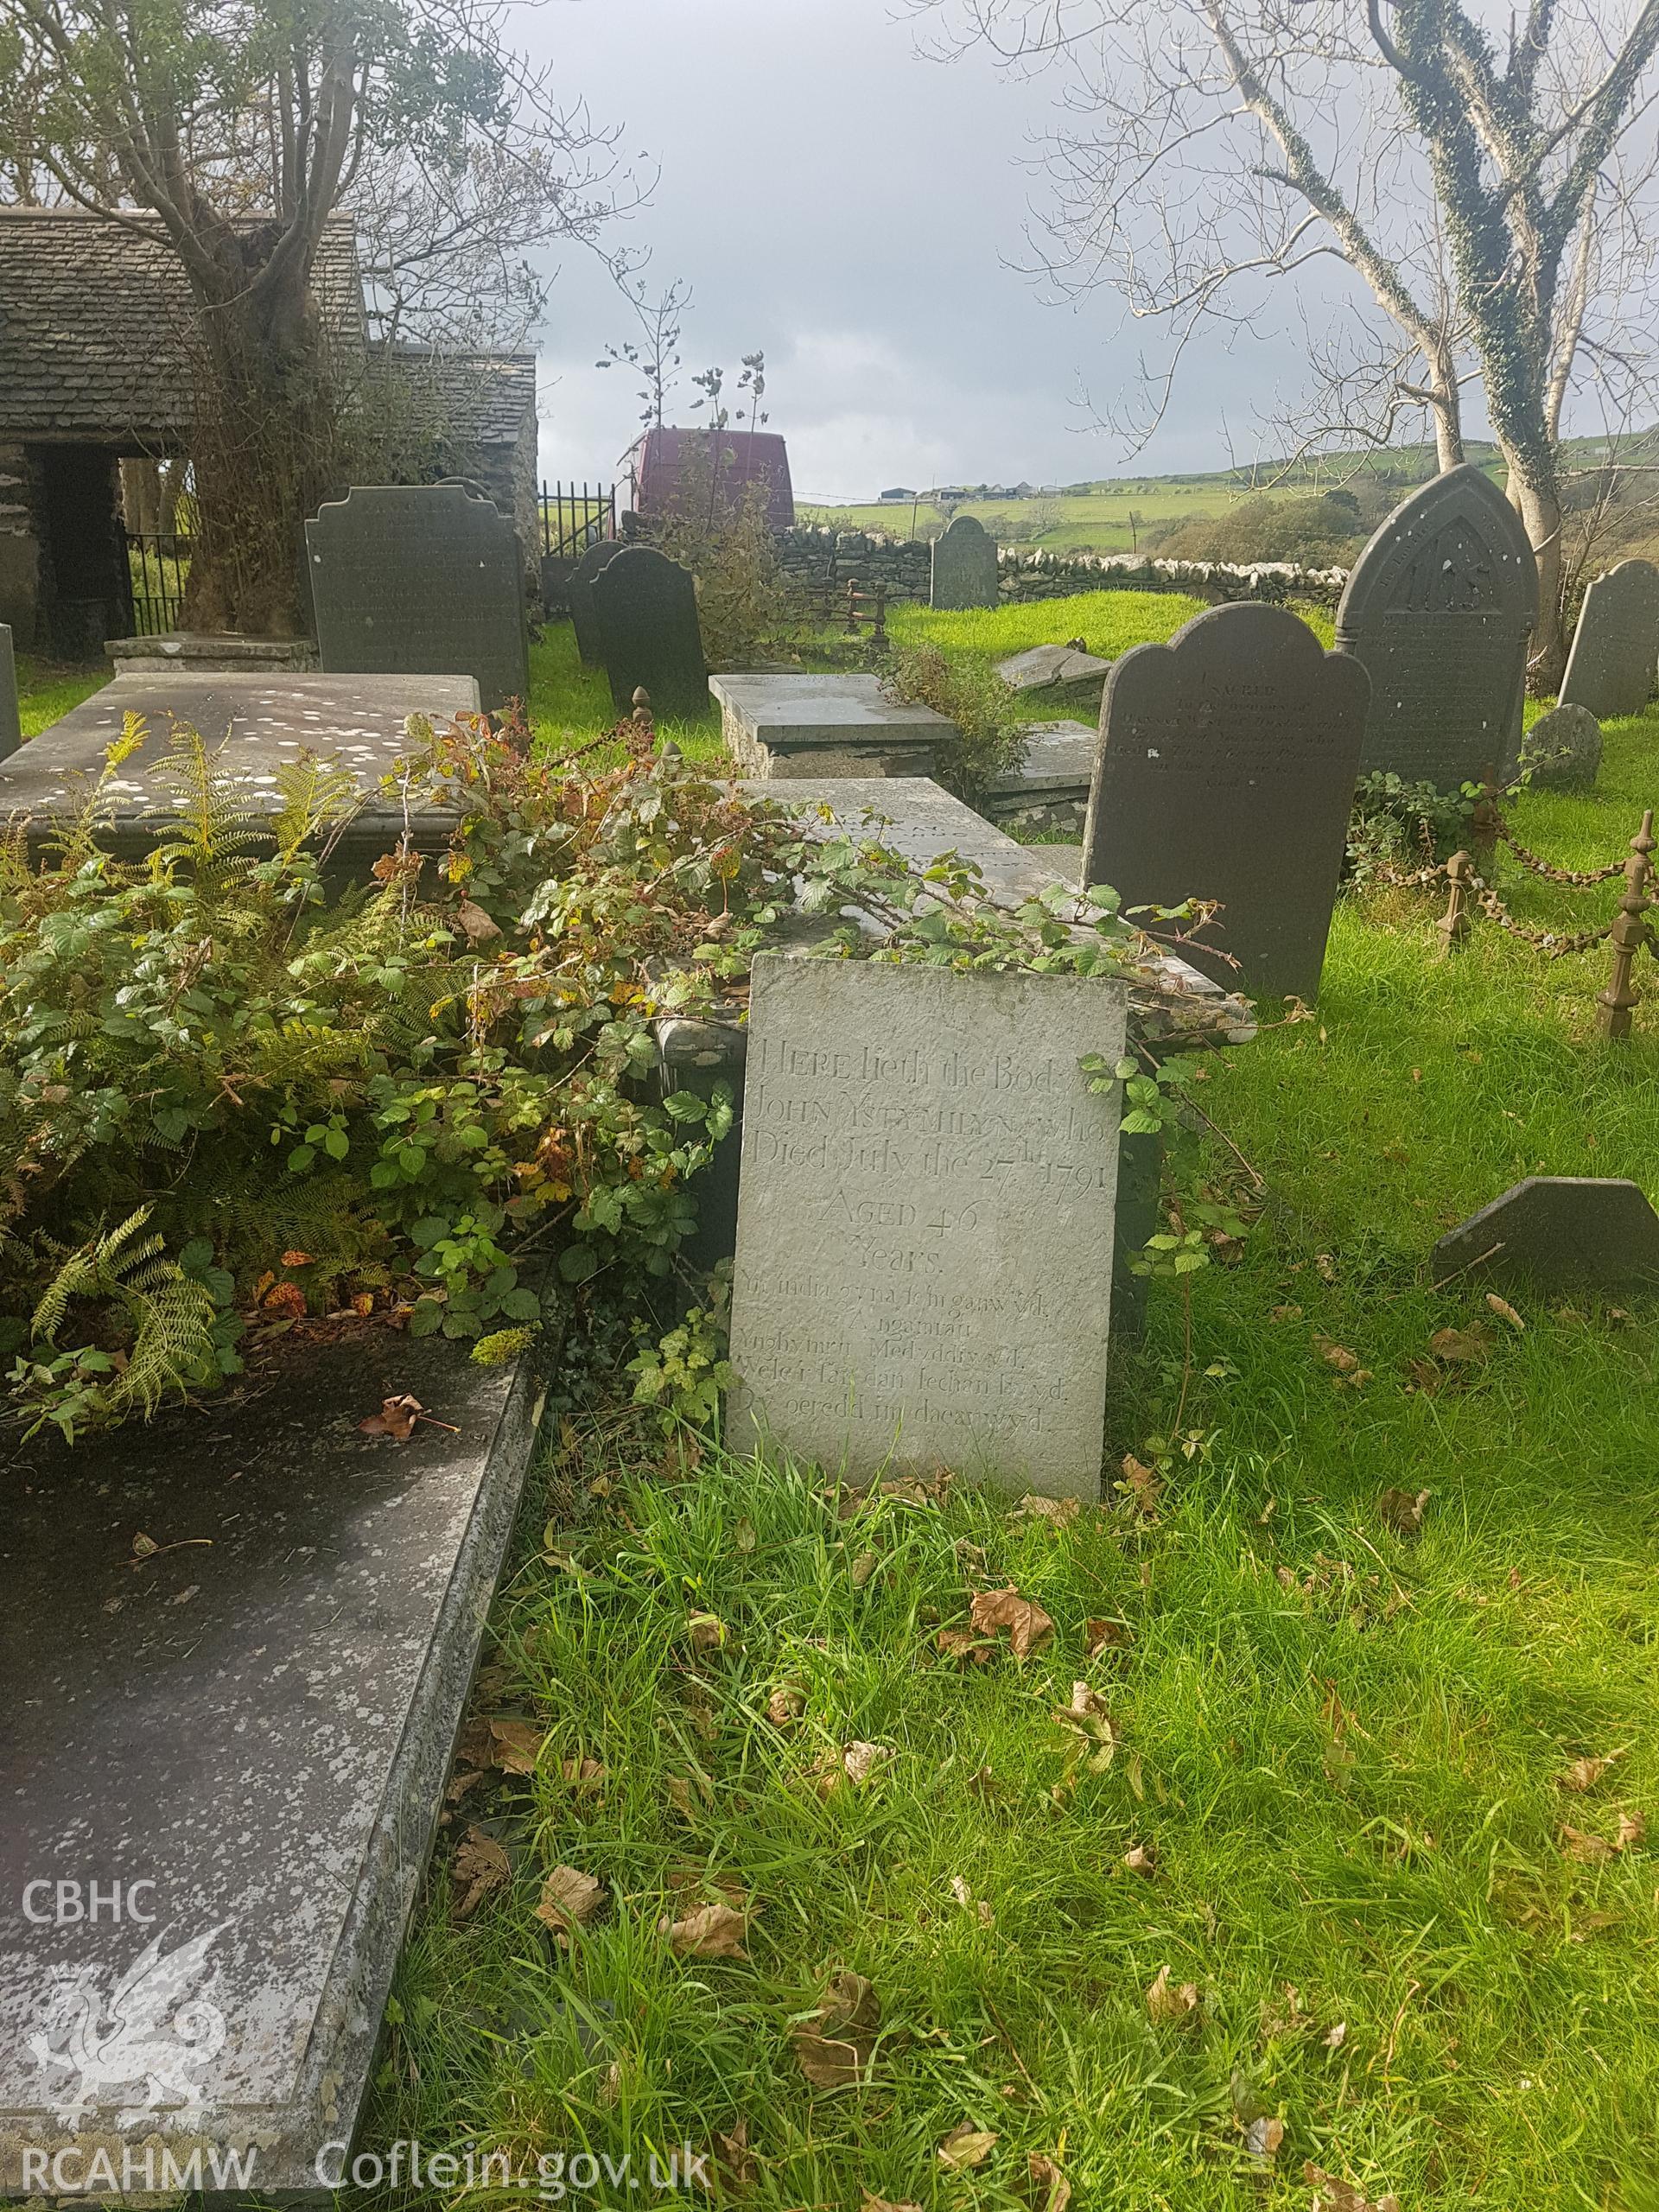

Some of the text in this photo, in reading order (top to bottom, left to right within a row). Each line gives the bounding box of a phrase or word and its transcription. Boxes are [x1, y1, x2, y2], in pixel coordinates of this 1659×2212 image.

[758, 1039, 851, 1079] HERE
[861, 1046, 930, 1085] lieth
[940, 1052, 986, 1089] the
[991, 1055, 1081, 1110] Body
[751, 1084, 835, 1122] JOHN
[1034, 1106, 1105, 1141] who
[748, 1128, 829, 1168] Died
[836, 1135, 916, 1189] July
[920, 1141, 969, 1179] the
[1039, 1161, 1107, 1207] 1791
[815, 1186, 993, 1238] AGED 46
[741, 1268, 770, 1294] Yn
[847, 1306, 868, 1331] A
[740, 1327, 852, 1362] Ynghymru
[864, 1364, 904, 1389] dan
[918, 1367, 989, 1395] lechan
[785, 1393, 865, 1421] oeredd
